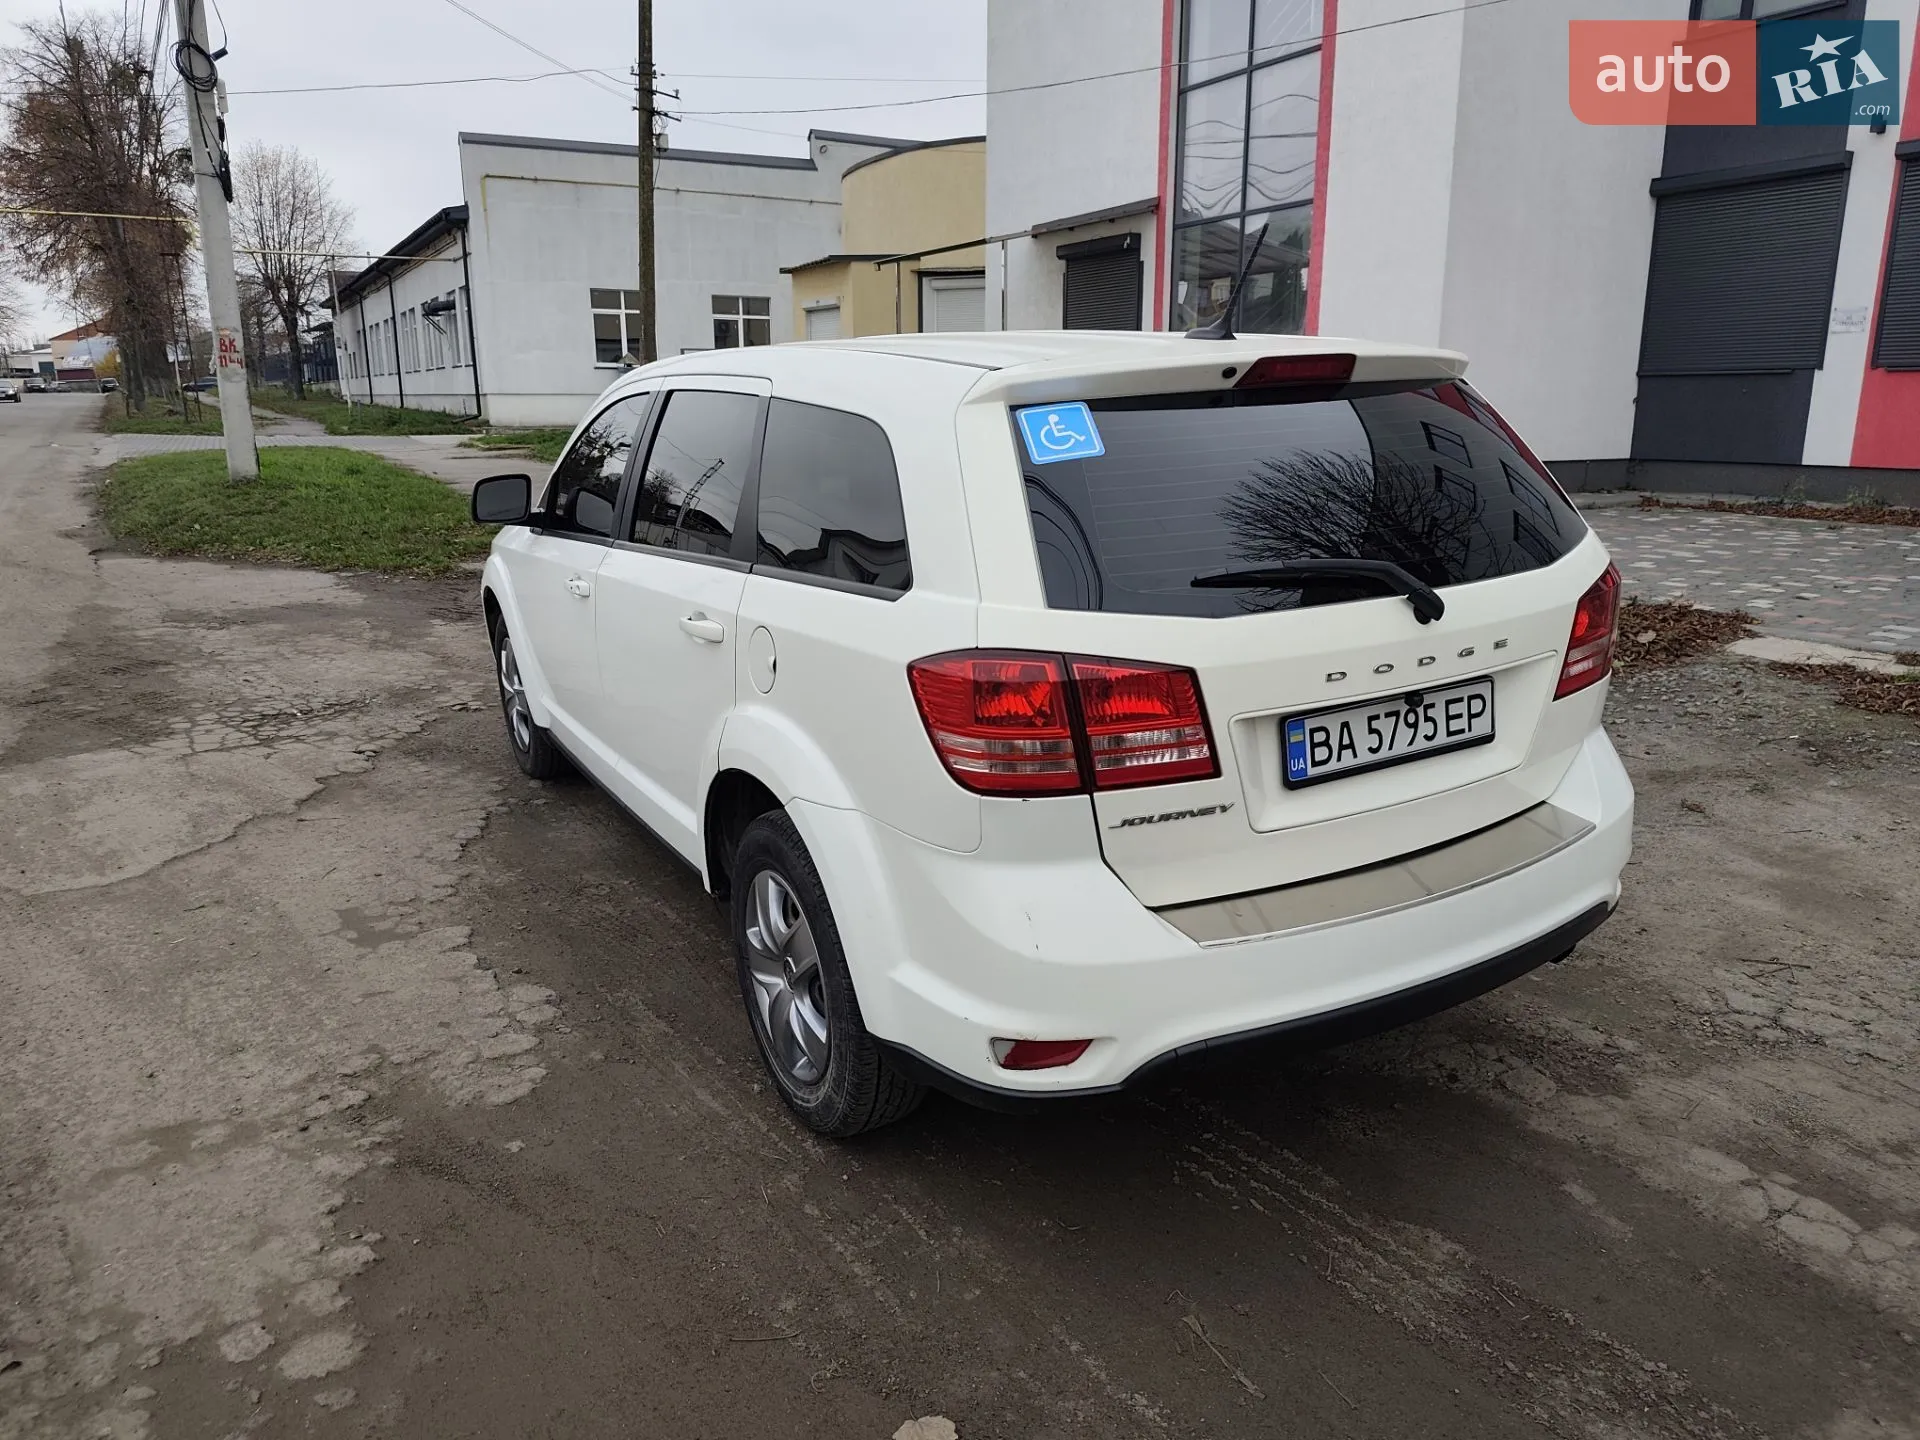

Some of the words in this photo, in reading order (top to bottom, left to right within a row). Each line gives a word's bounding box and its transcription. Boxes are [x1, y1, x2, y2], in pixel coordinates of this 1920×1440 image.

[1325, 638, 1509, 682] DODGE
[1308, 720, 1358, 769] BA
[1366, 702, 1438, 755] 5795
[1444, 693, 1488, 738] EP
[1290, 757, 1306, 772] UA
[1108, 801, 1236, 830] JOURNEY
